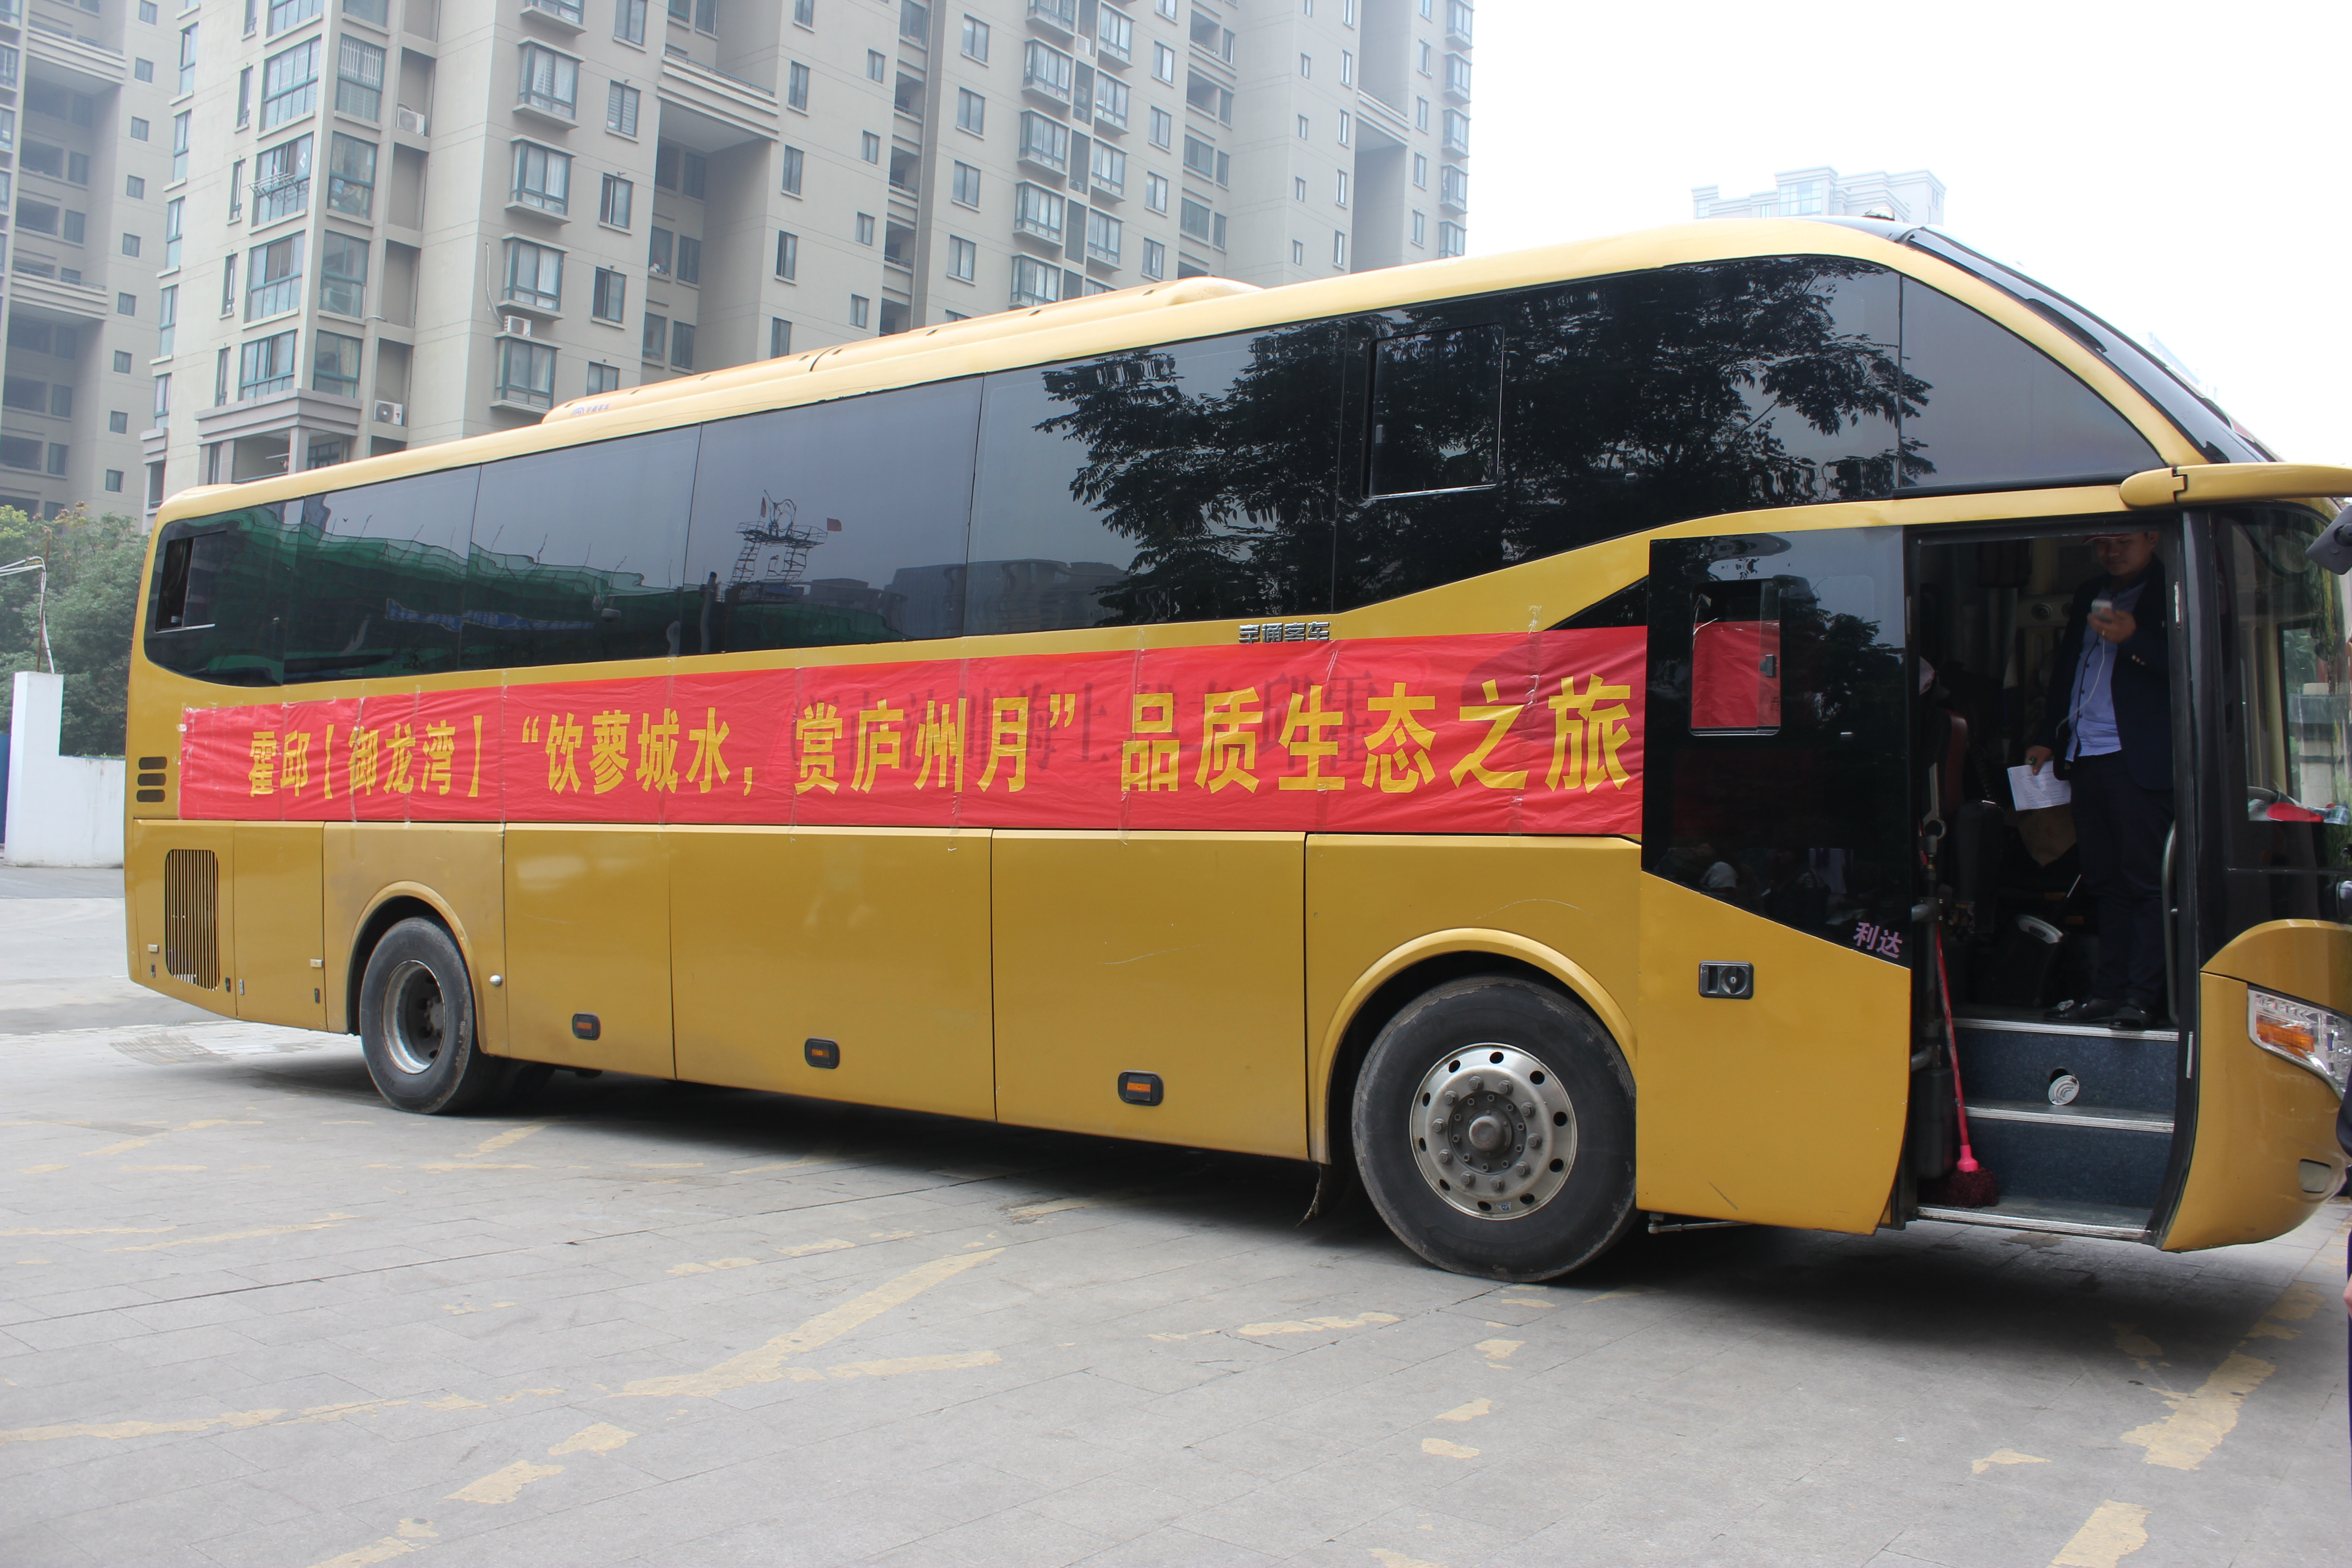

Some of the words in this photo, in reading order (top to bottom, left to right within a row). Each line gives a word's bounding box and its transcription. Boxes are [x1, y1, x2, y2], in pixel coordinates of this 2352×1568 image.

[1239, 621, 1330, 644] 宇通客车
[1853, 922, 1903, 959] 利达
